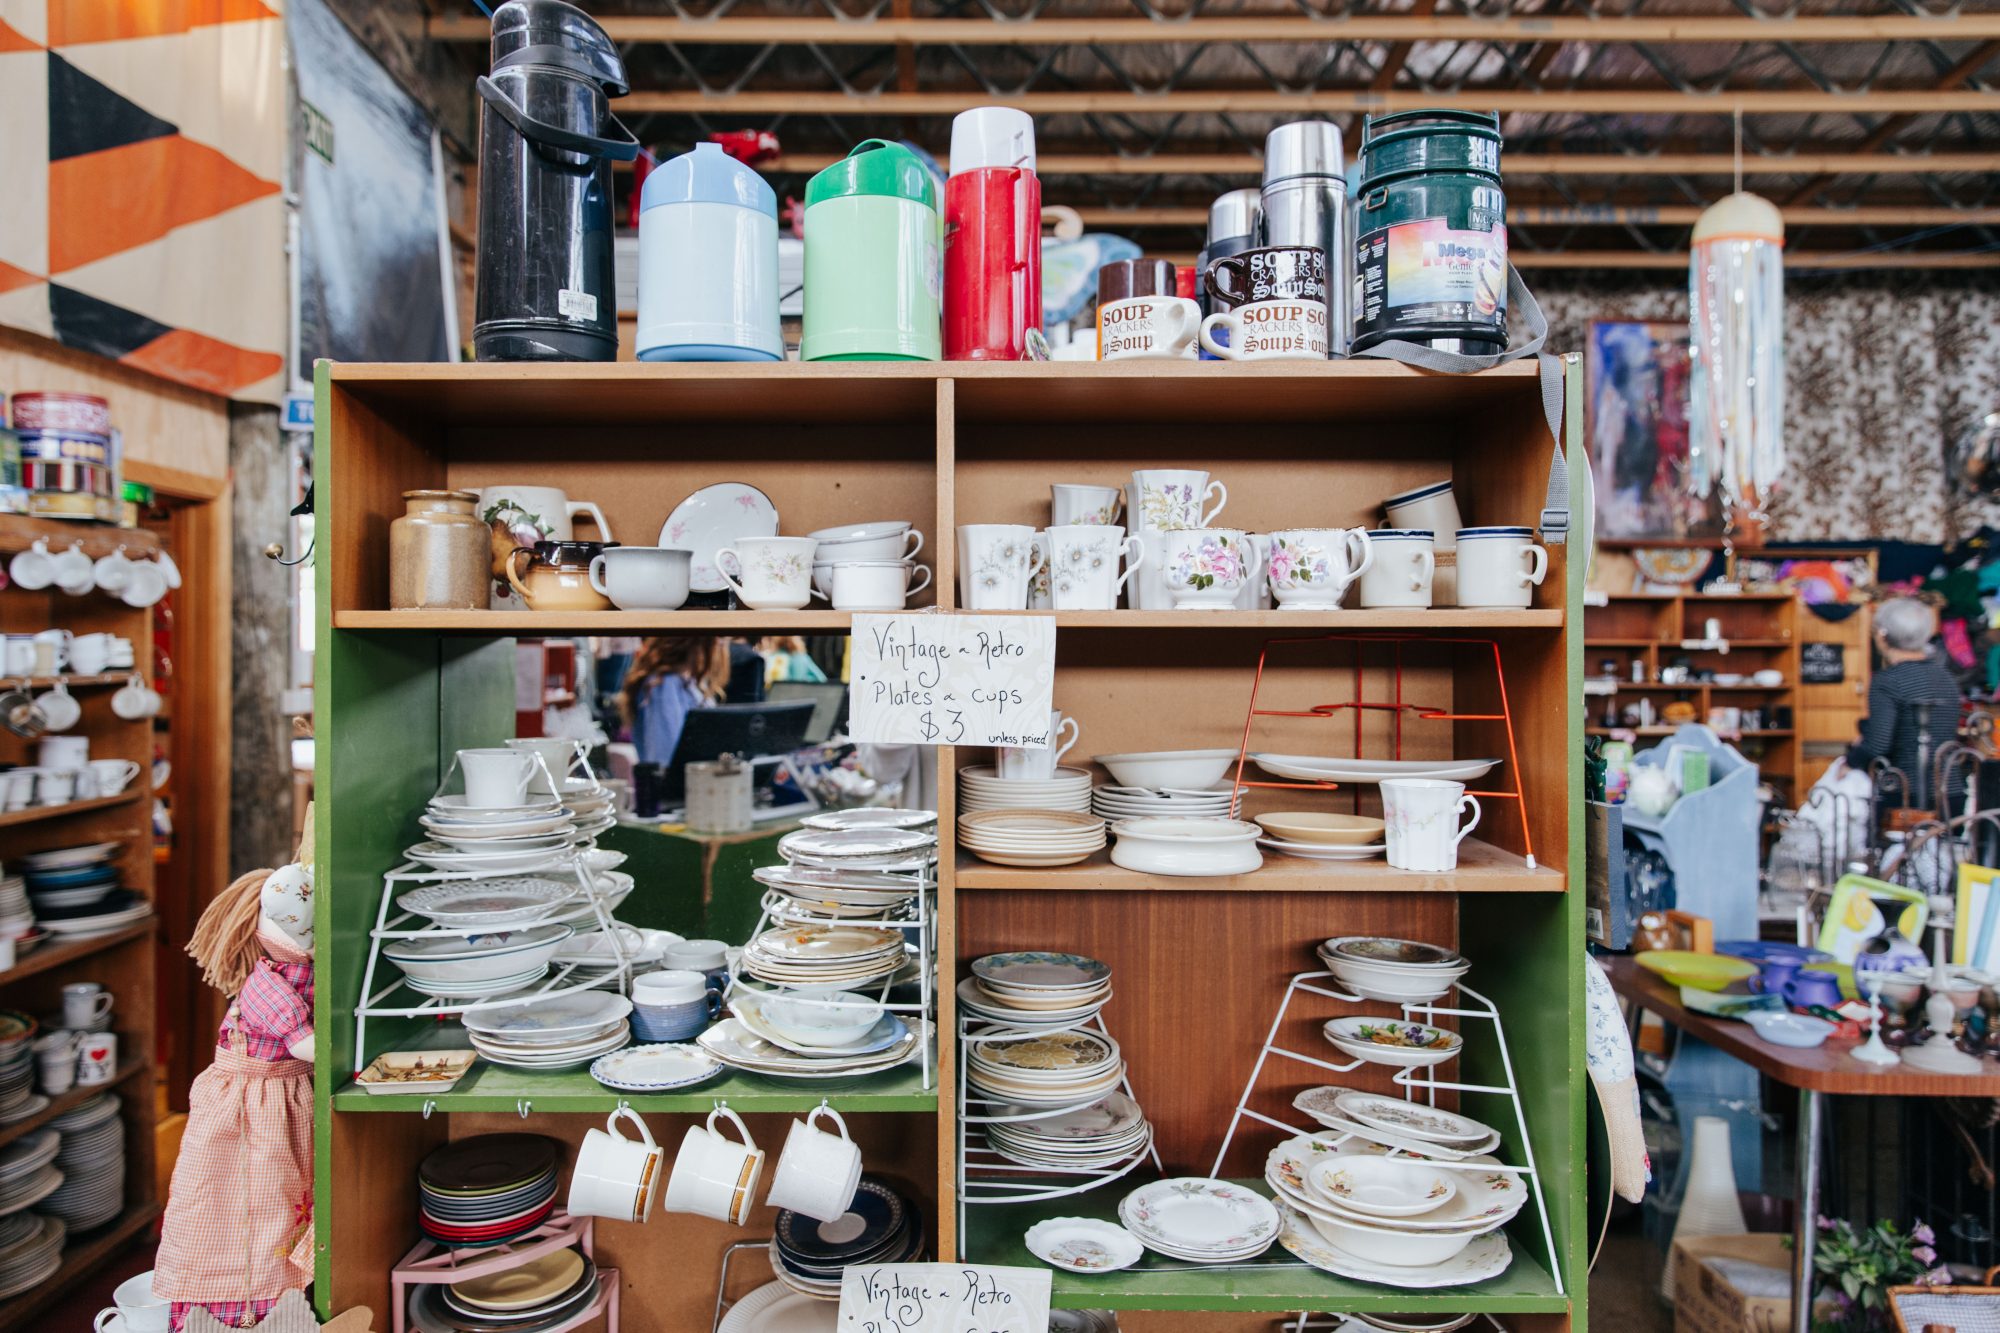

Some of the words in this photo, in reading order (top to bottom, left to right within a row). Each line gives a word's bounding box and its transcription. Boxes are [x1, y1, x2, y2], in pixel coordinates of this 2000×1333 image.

[1439, 243, 1486, 260] Mega
[1103, 304, 1153, 327] SOUP
[1243, 306, 1303, 325] SOUP
[1110, 335, 1153, 353] Soup
[1244, 336, 1292, 355] Soup
[872, 620, 951, 689] Vintage
[976, 630, 1025, 670] Retro
[872, 680, 934, 706] Plates
[919, 709, 965, 743] $3
[988, 731, 1018, 745] unless
[1022, 730, 1049, 746] priced
[861, 1268, 932, 1327] Vintage
[962, 1270, 1012, 1316] Retro
